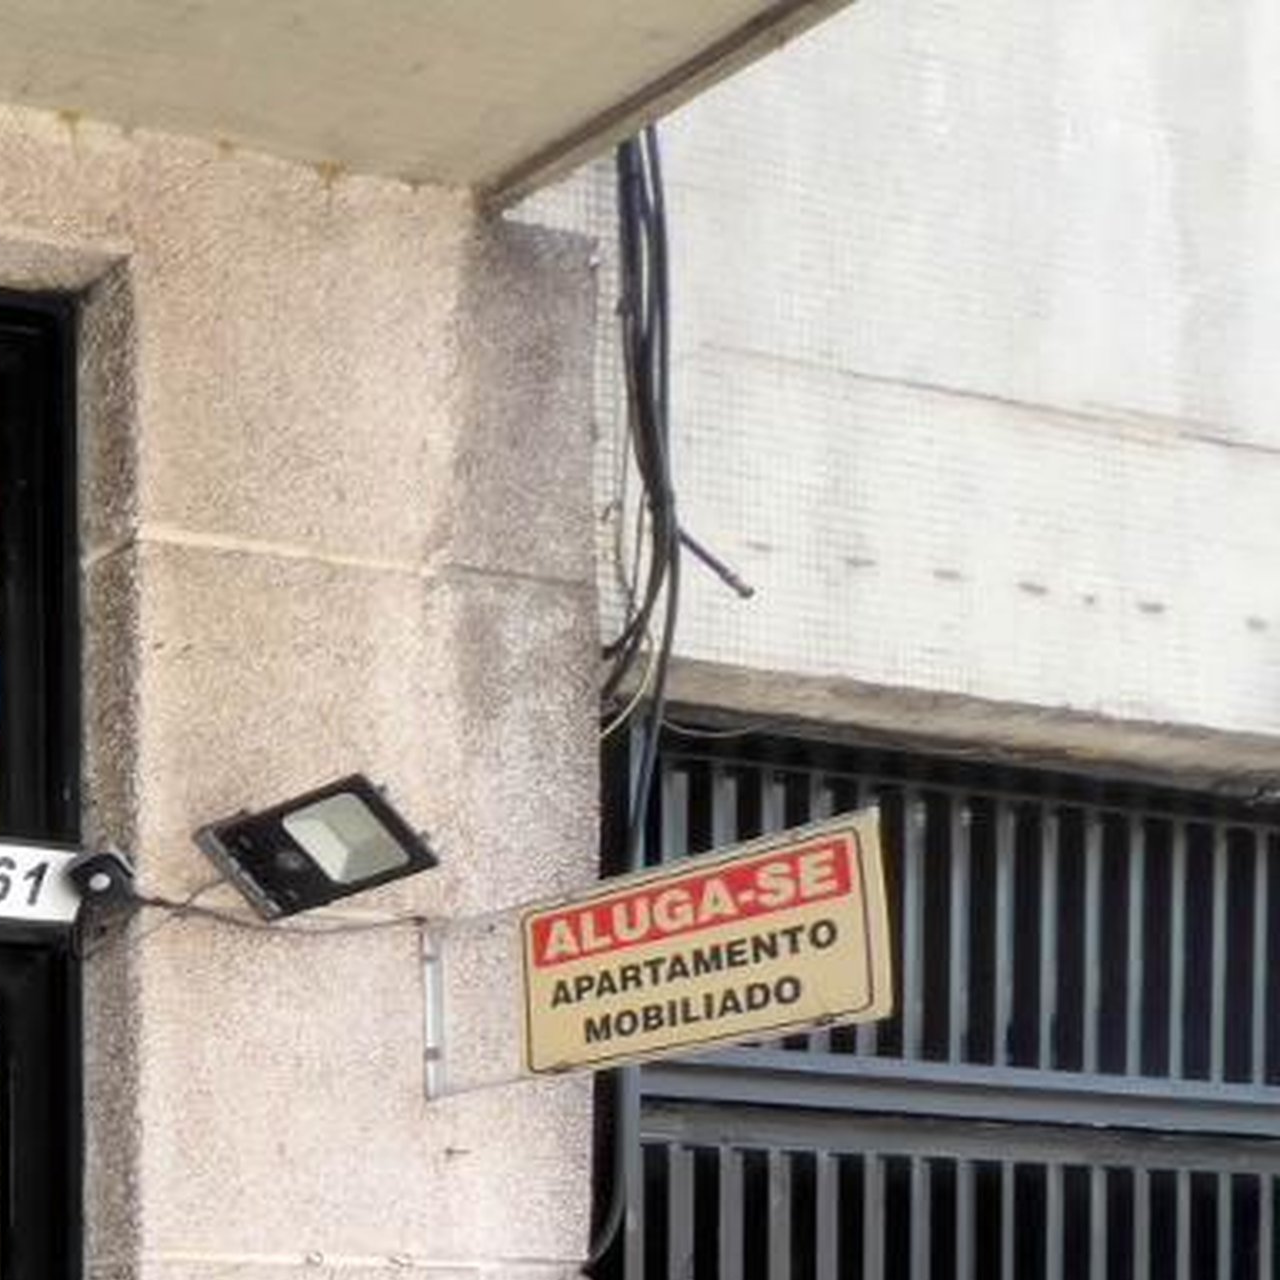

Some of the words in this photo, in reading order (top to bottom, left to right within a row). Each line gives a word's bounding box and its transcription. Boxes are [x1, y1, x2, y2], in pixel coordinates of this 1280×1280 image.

[540, 848, 840, 961] ALUGA-SE
[550, 919, 838, 1009] APARTAMENTO
[583, 976, 802, 1044] MOBILIADO
